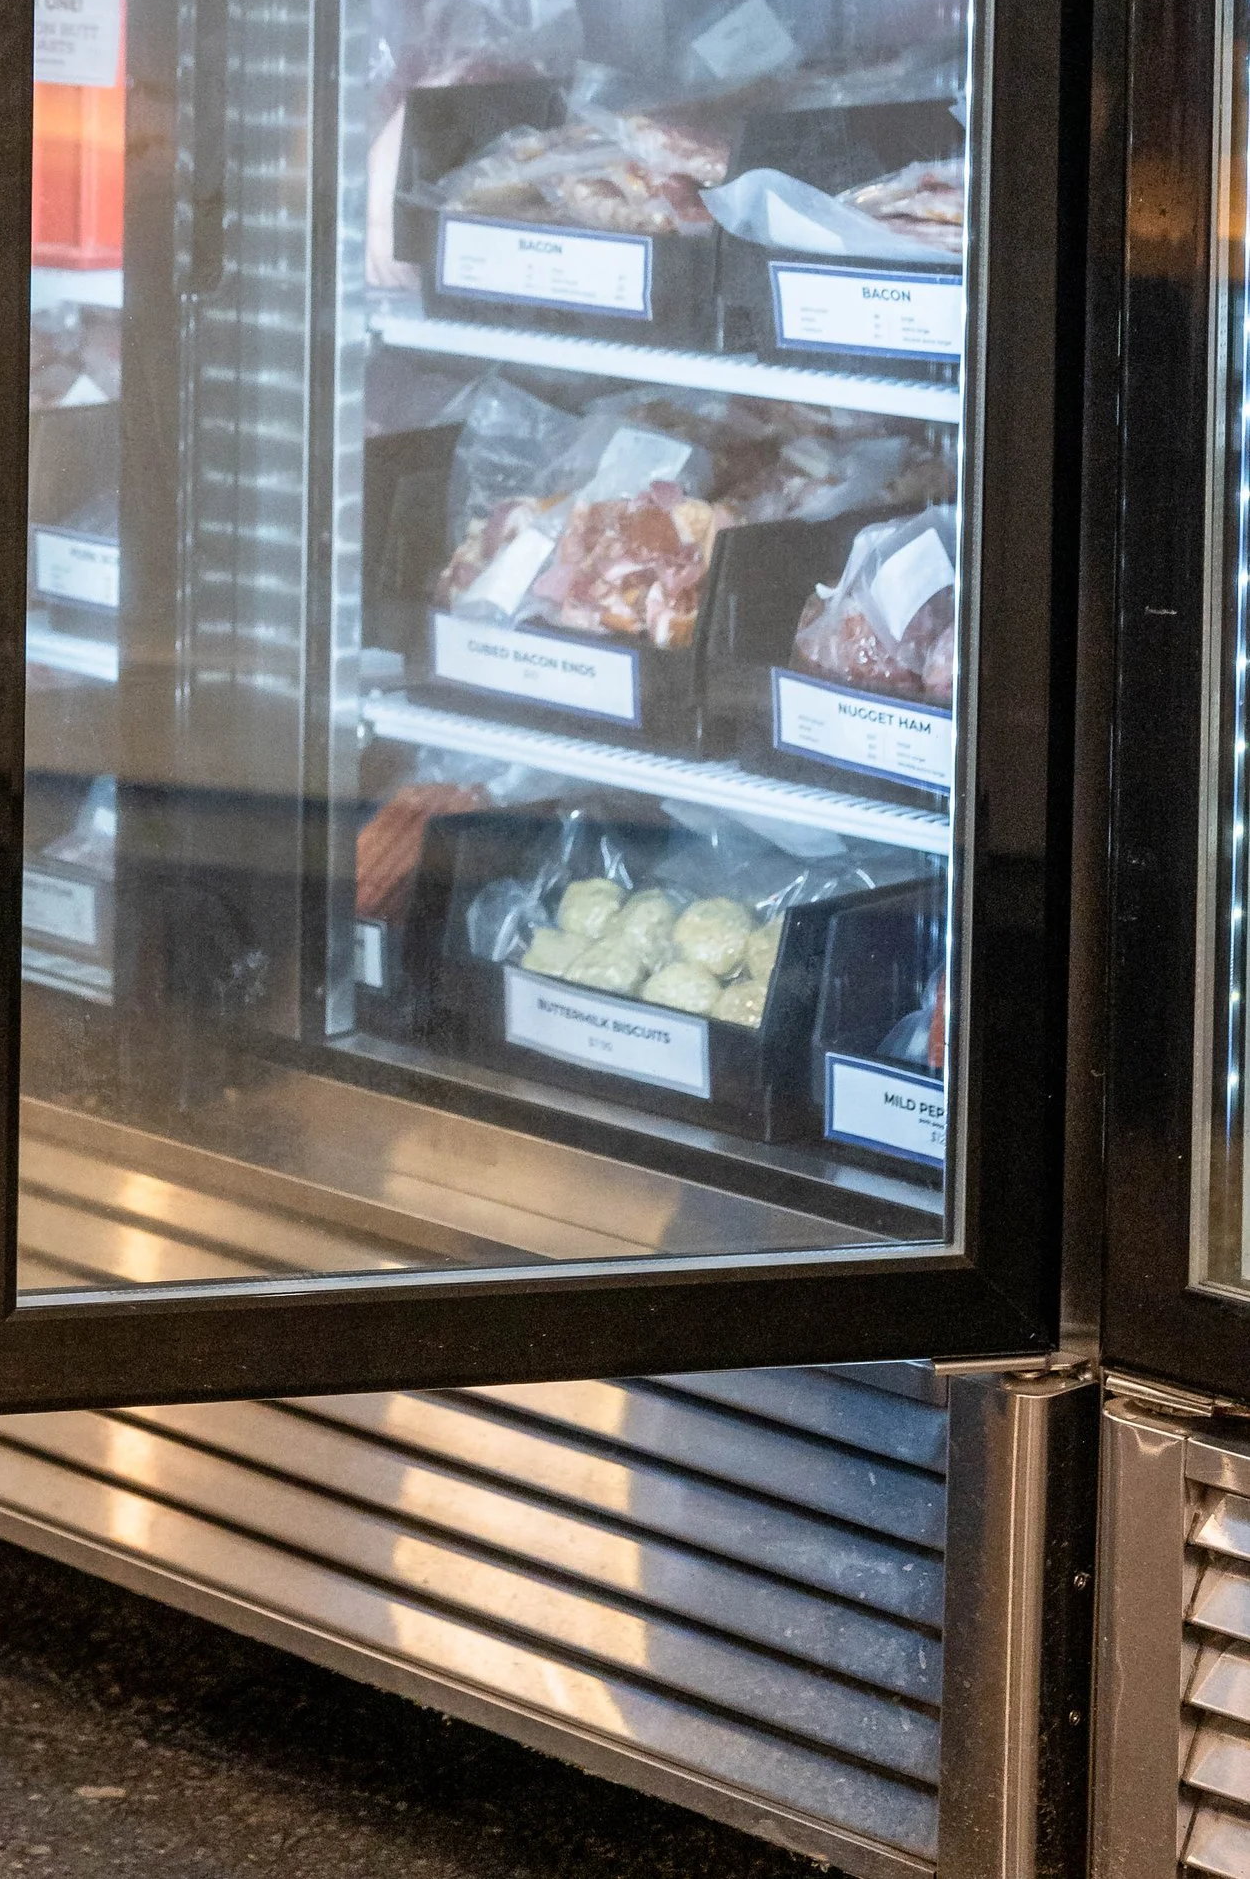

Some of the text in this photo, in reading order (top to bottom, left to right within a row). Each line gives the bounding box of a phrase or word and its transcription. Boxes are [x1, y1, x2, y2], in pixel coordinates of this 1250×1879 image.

[518, 238, 563, 255] BACON
[862, 286, 912, 303] BACON
[467, 640, 509, 660] CUBED
[513, 649, 558, 670] BACON
[562, 660, 596, 679] ENDS
[838, 702, 932, 735] NUGGET HAM
[537, 997, 672, 1045] BUTTERMILK BISCUITS
[883, 1091, 916, 1111] MILD
